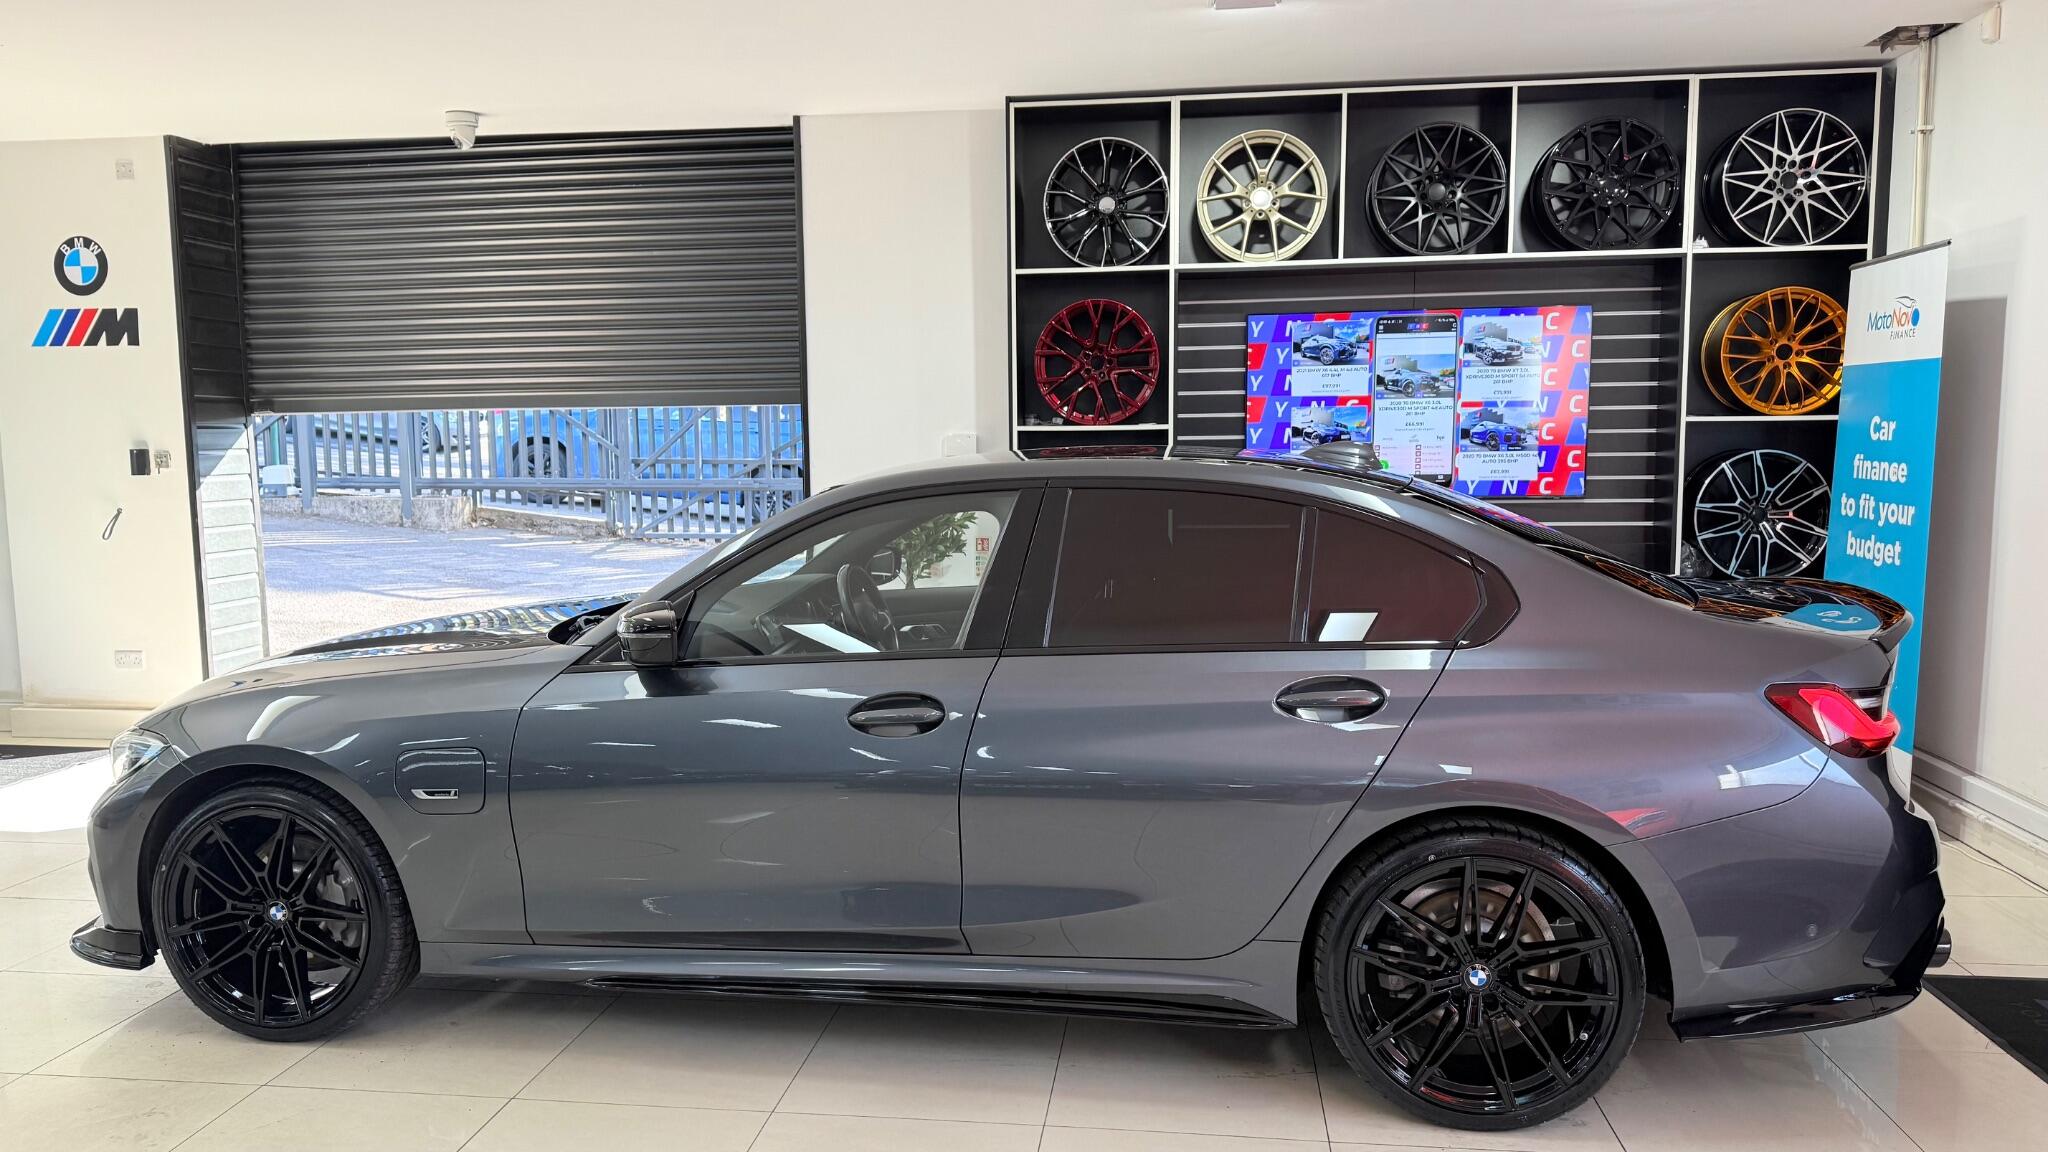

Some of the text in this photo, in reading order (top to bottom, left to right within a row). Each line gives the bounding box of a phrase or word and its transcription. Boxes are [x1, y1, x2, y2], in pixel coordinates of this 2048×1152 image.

[60, 237, 102, 256] BMW
[1889, 328, 1916, 341] FINANCE
[1870, 415, 1896, 441] Car
[1853, 453, 1908, 483] finance
[1841, 492, 1916, 527] to fit your
[1846, 530, 1902, 567] budget
